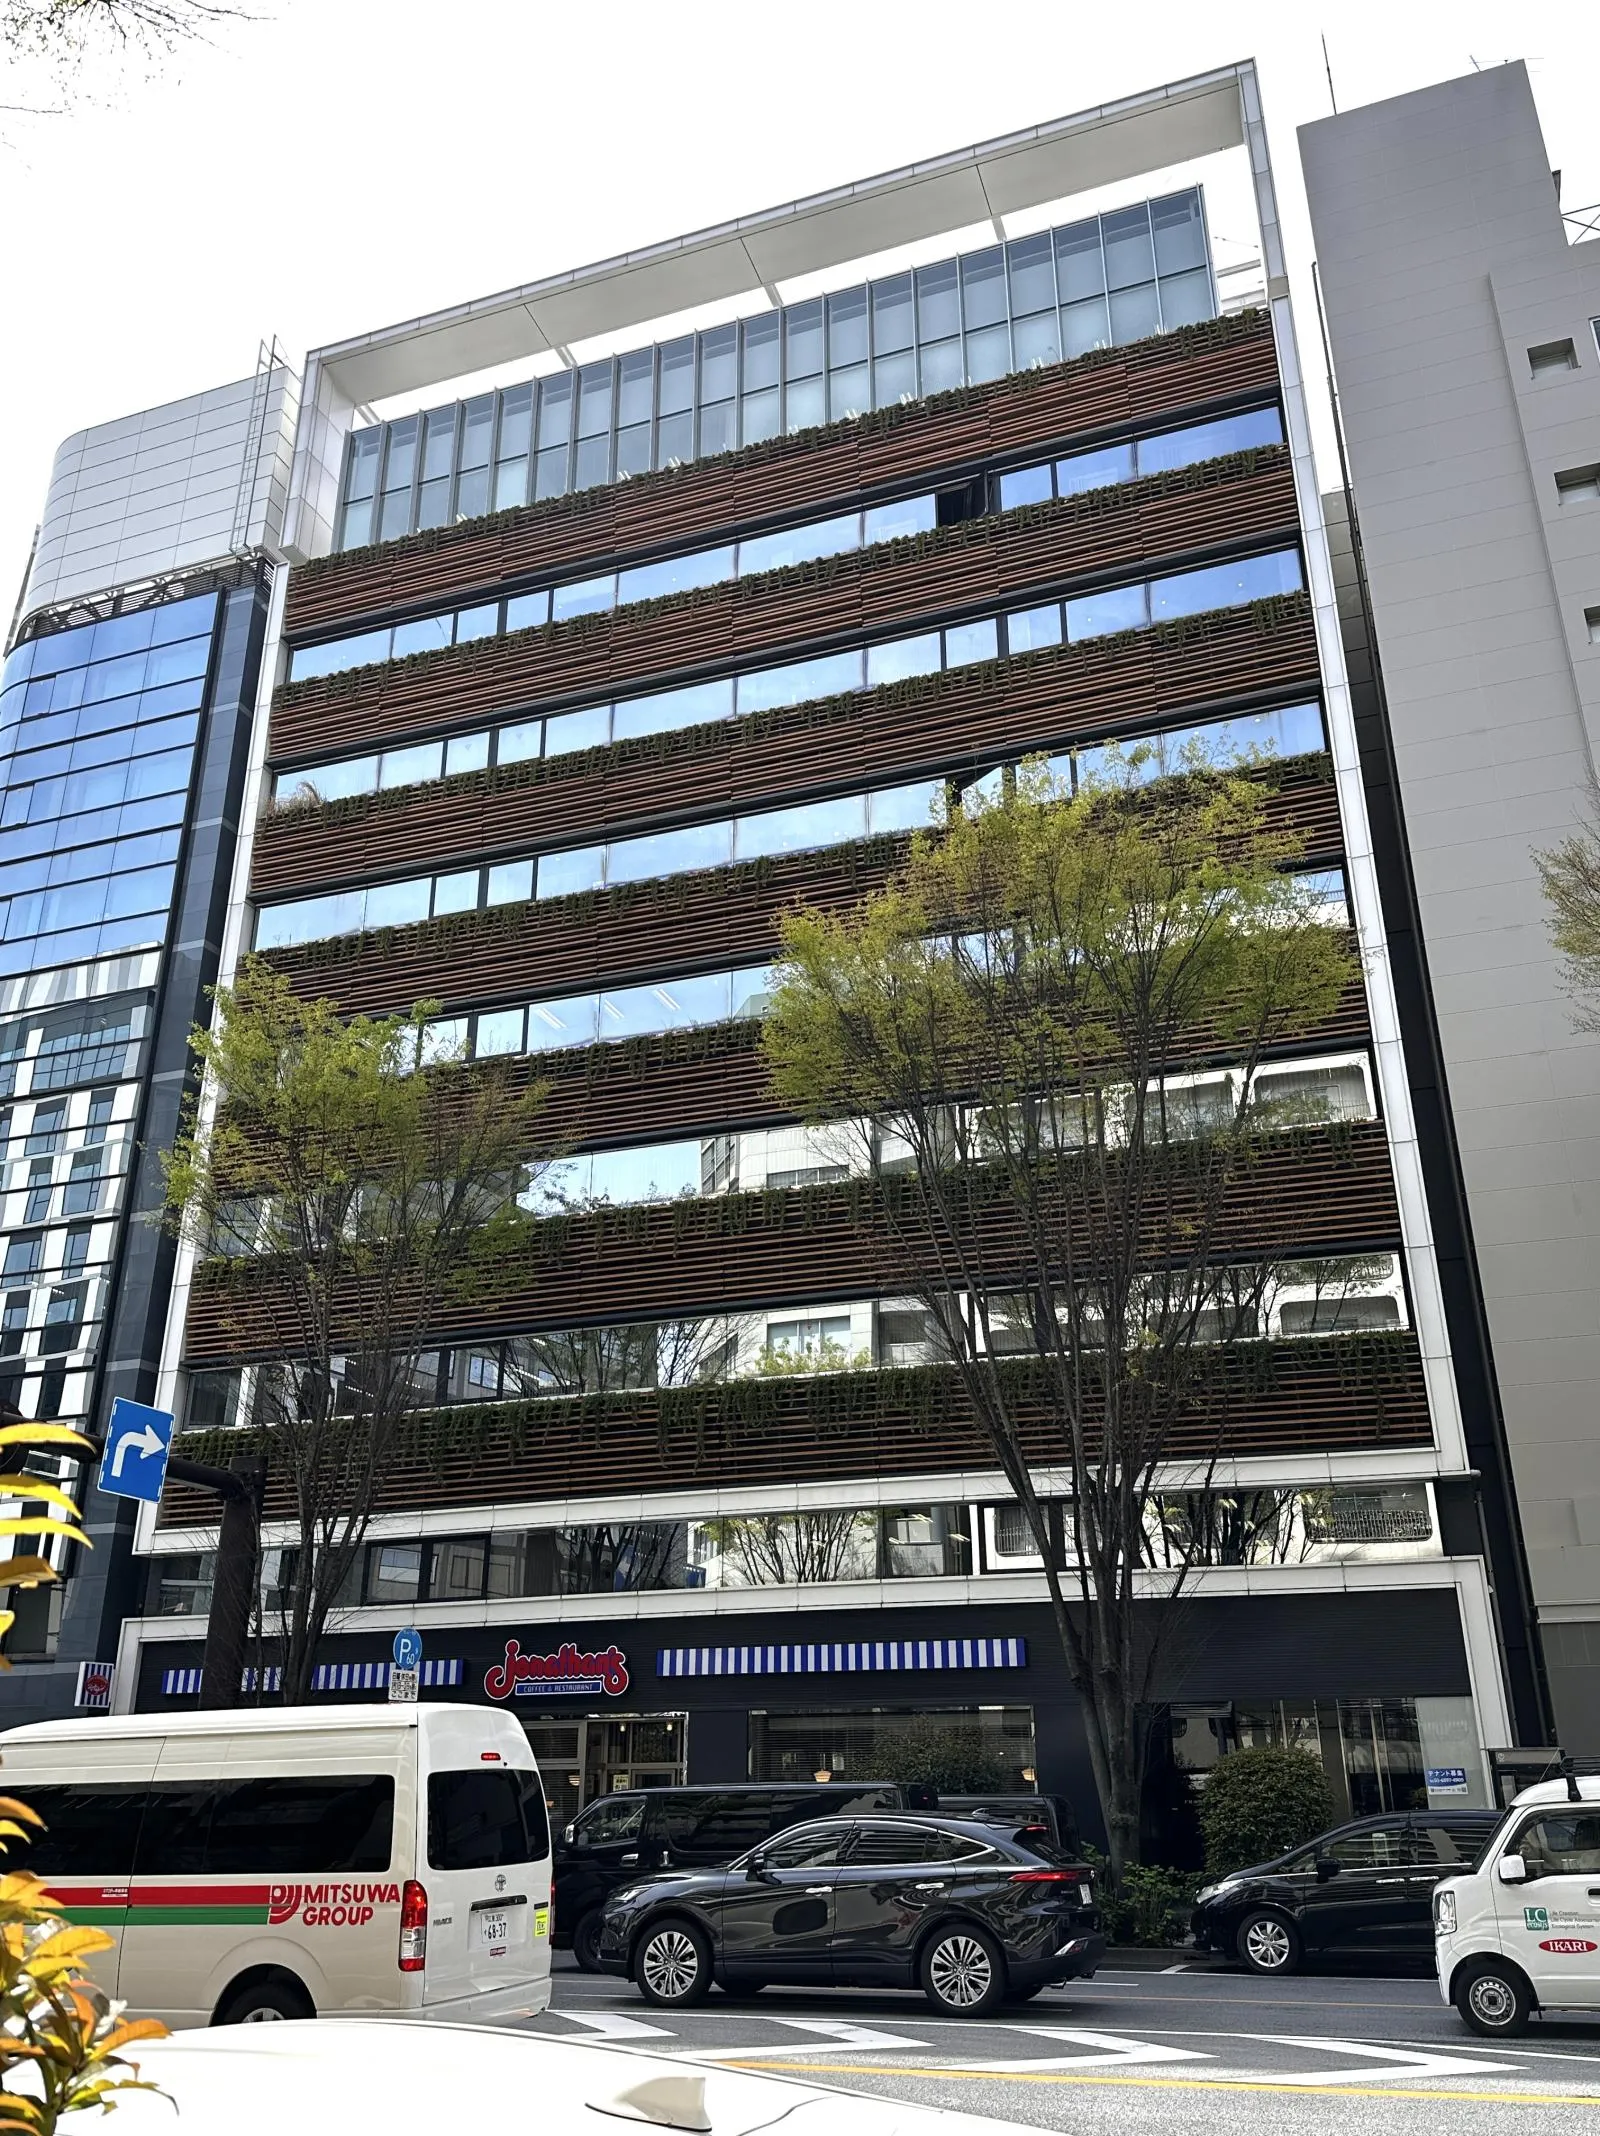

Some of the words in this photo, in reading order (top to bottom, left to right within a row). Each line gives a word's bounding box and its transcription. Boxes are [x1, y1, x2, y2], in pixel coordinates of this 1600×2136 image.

[399, 1638, 412, 1664] P
[523, 1685, 545, 1693] COFFEE
[554, 1683, 593, 1692] RESTAURANT
[303, 1883, 400, 1903] MITSUWA
[302, 1906, 374, 1926] GROUP
[1525, 1908, 1546, 1922] LC
[1548, 1941, 1588, 1951] IKARI
